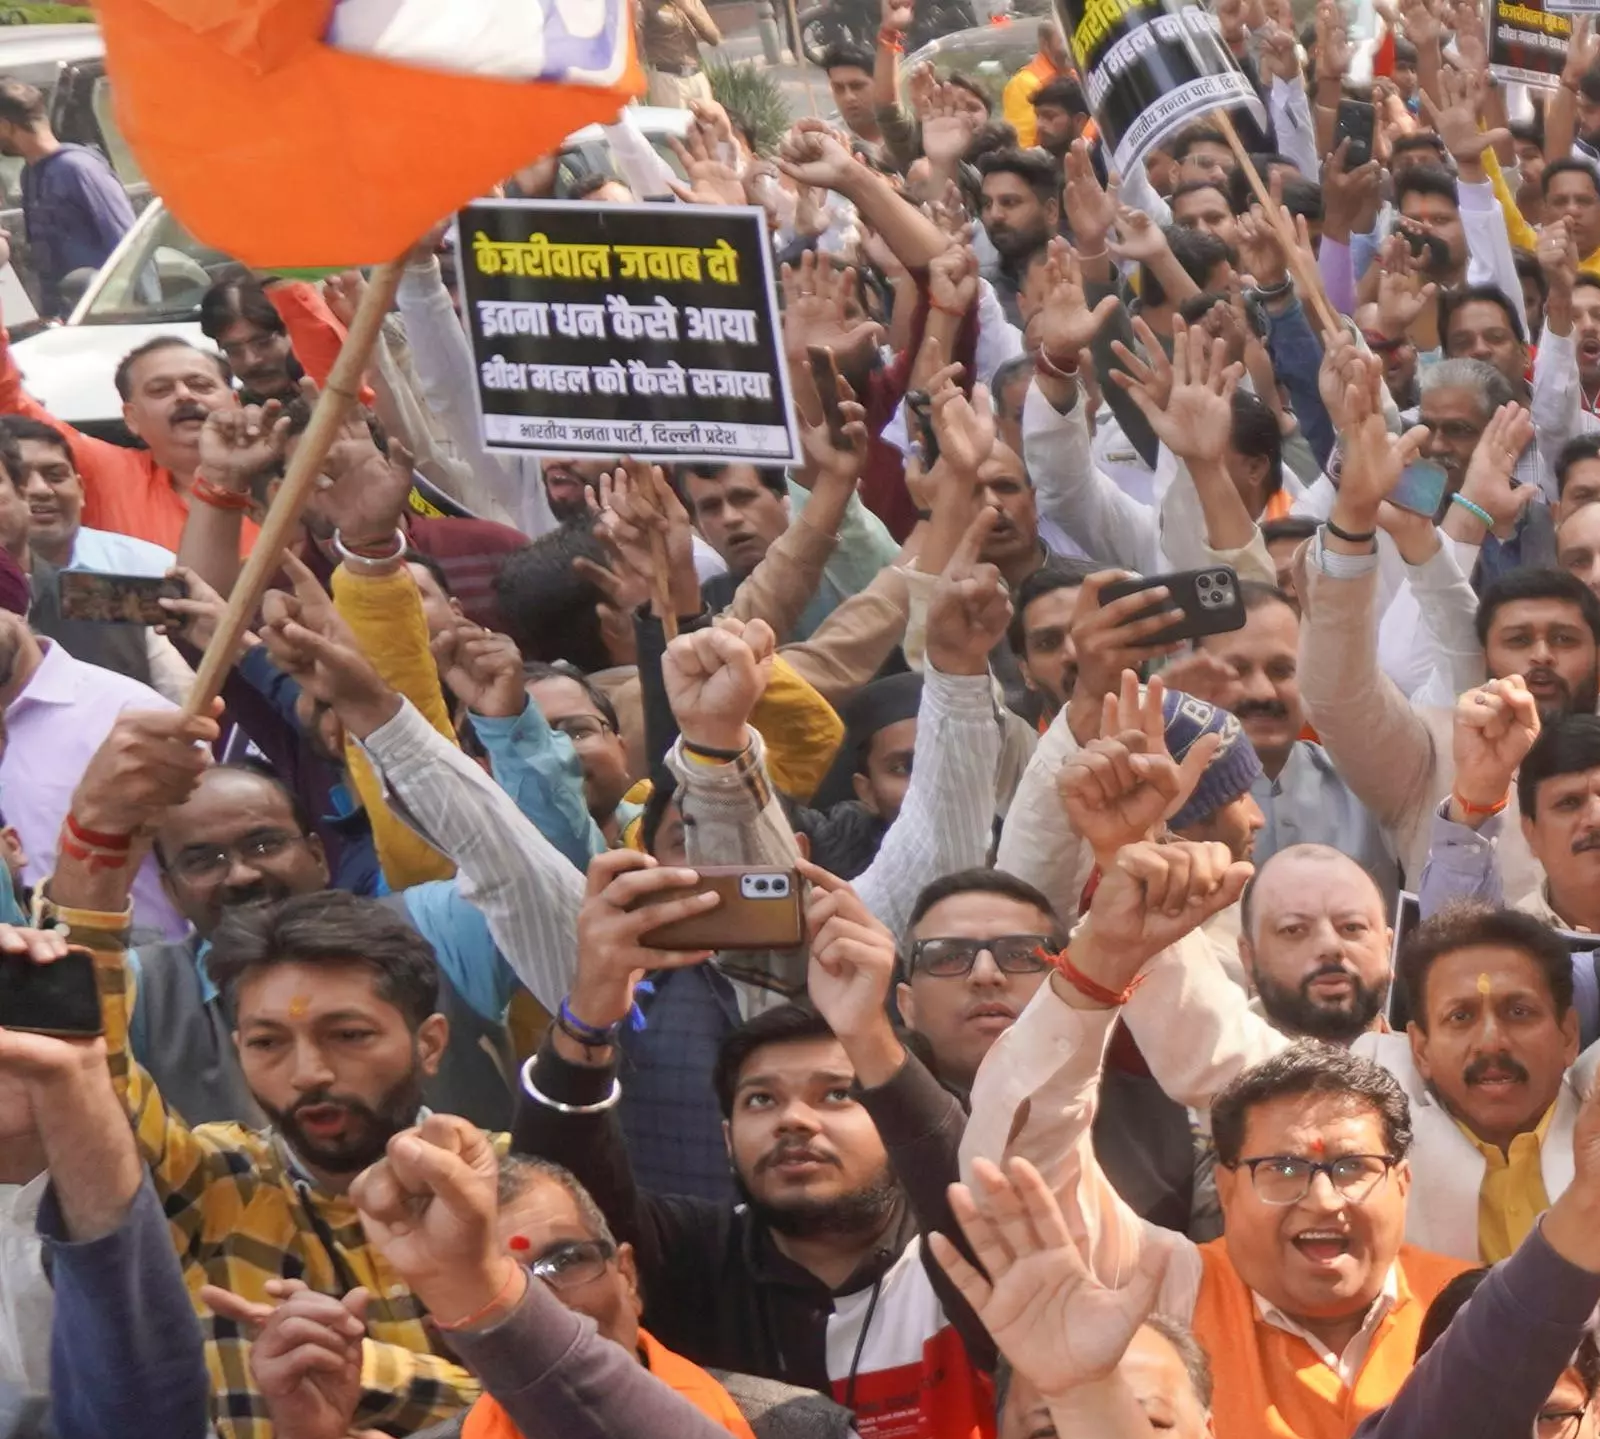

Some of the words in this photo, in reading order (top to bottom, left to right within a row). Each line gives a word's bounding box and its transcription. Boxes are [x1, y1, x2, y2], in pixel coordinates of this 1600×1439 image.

[472, 230, 611, 279] केजरीवाल
[612, 244, 701, 282] जवाब
[703, 238, 740, 286] दो
[477, 300, 550, 339] इतना
[552, 302, 606, 340] धन
[607, 293, 679, 341] कैसे
[686, 306, 758, 345] आया
[481, 354, 528, 391] शीश
[528, 363, 591, 394] महल
[591, 359, 628, 395] को
[627, 359, 687, 397] कैसे
[690, 368, 773, 400] सजाया
[520, 420, 567, 442] भारतीय
[570, 425, 610, 443] जनता
[652, 424, 701, 444] दिल्ली
[704, 428, 737, 446] प्रदेश
